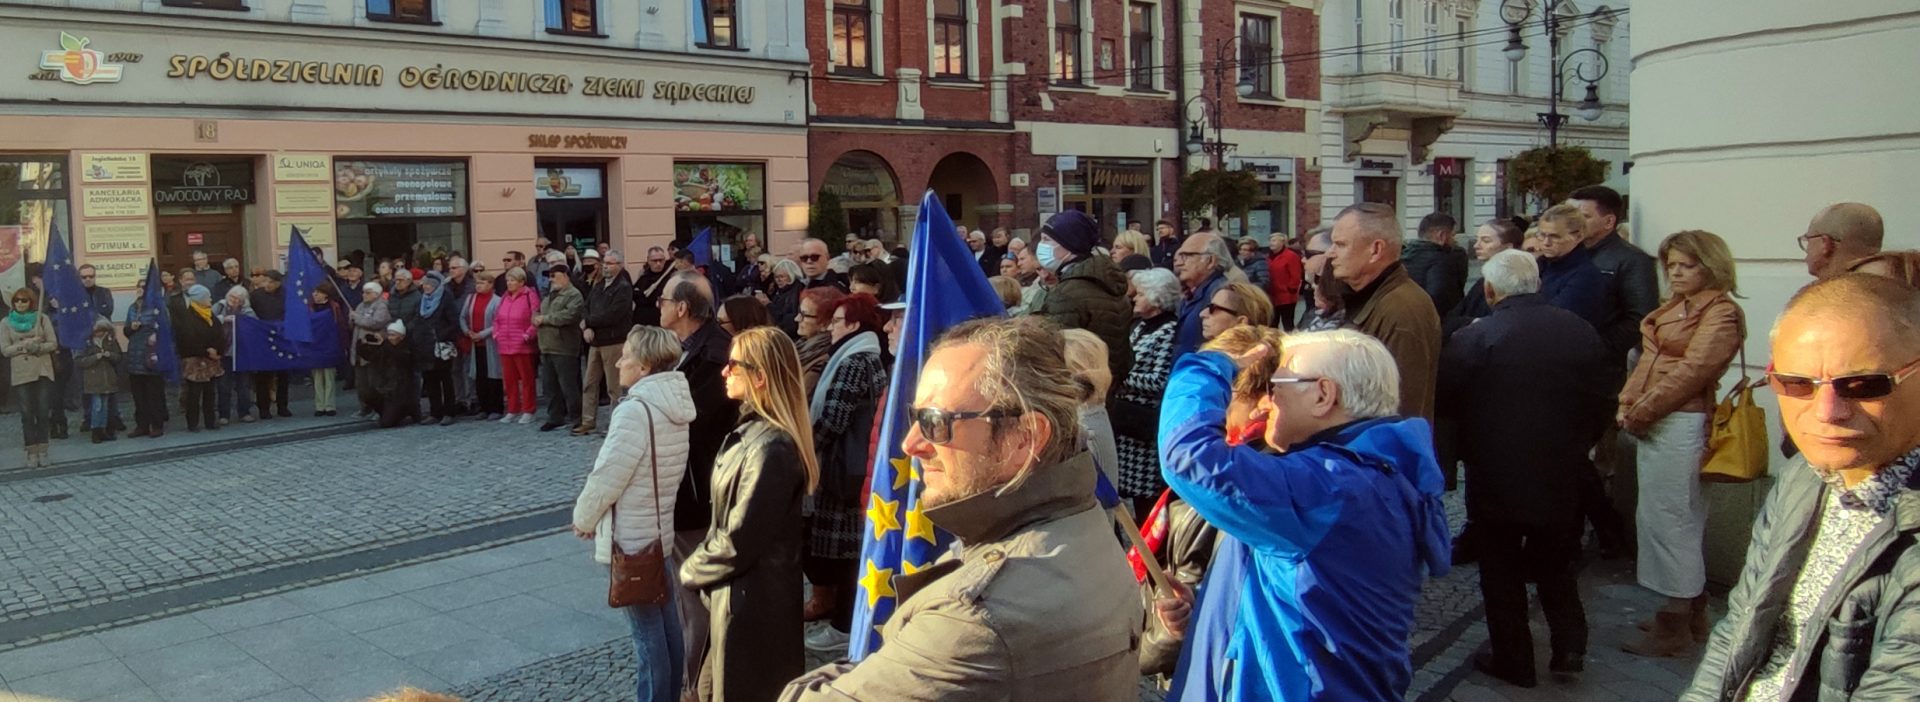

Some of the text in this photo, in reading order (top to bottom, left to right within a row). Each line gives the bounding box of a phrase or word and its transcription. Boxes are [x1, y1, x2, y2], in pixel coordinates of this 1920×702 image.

[167, 52, 755, 105] SPÓŁDZIELNIA OGRODNICZA ZIEMI SĄDECKIEJ
[198, 123, 215, 139] 18
[528, 132, 628, 150] SKLEP SPOŻYWCZY
[295, 160, 326, 169] UNIQA
[1439, 164, 1452, 176] M
[396, 179, 452, 190] monopolowe
[155, 188, 248, 202] OWOCOWY RAJ
[394, 191, 453, 203] przemysłowe
[375, 206, 405, 214] owoce
[413, 206, 453, 215] warzywa
[90, 241, 130, 250] OPTIMUM
